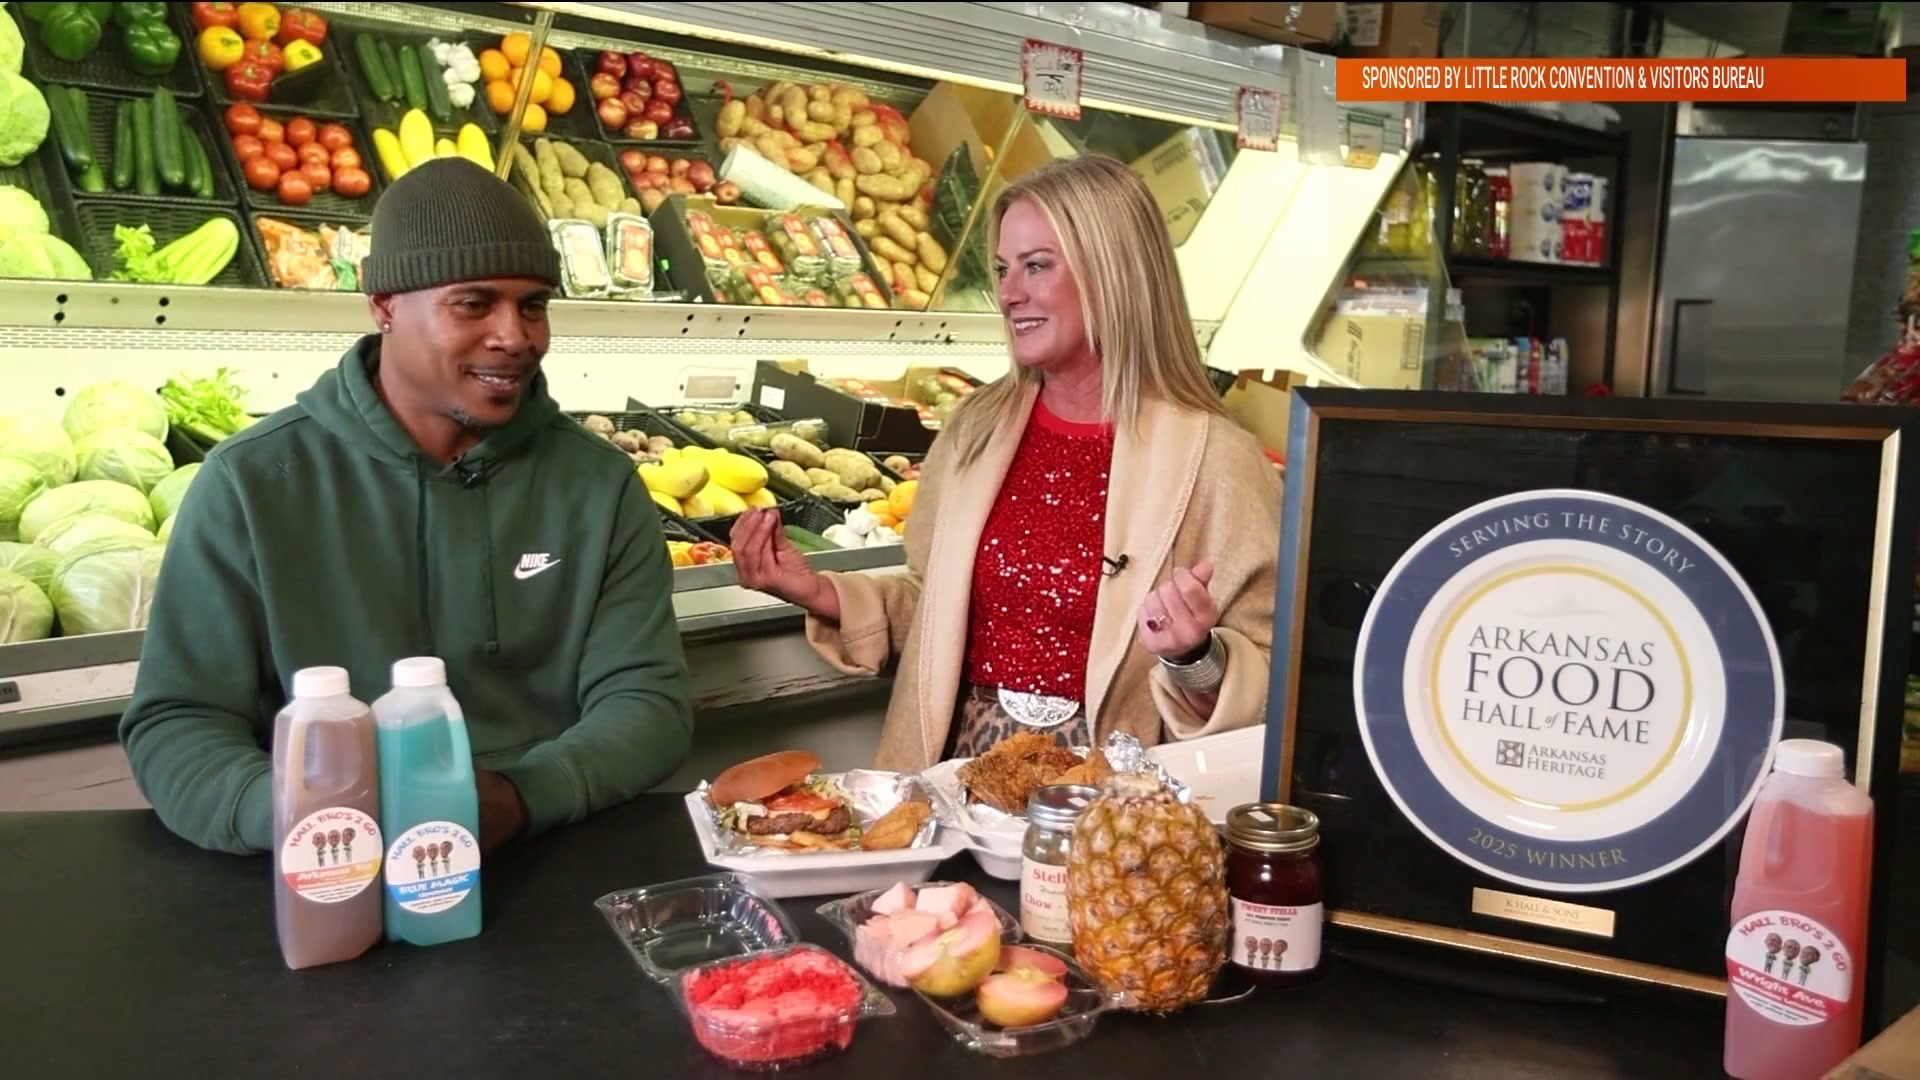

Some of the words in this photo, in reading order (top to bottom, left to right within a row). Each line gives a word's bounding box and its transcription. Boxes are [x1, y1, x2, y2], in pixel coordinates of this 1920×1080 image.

[520, 553, 551, 569] NIKE
[1448, 512, 1550, 557] SERVING
[1561, 512, 1611, 534] THE
[1618, 524, 1696, 576] STORY
[1468, 625, 1655, 667] ARKANSAS
[1464, 651, 1655, 713] FOOD
[1461, 698, 1541, 731] HALL
[1544, 712, 1561, 729] of
[1562, 711, 1650, 745] FAME
[1526, 758, 1606, 780] HERITAGE
[1527, 744, 1608, 766] ARKANSAS
[289, 822, 317, 847] HALL
[317, 811, 353, 823] BRO'S
[354, 816, 364, 825] 2
[391, 836, 416, 861] HALL
[416, 825, 450, 837] BRO'S
[451, 829, 460, 837] 2
[1467, 828, 1517, 859] 2025
[1526, 847, 1628, 869] WINNER
[430, 873, 470, 889] MAGIC
[1024, 892, 1053, 910] Chow
[1506, 898, 1514, 909] K
[1515, 900, 1539, 912] HALL
[1541, 904, 1550, 913] &
[1552, 906, 1580, 920] SONS
[1738, 916, 1775, 936] HALL
[1779, 916, 1824, 940] BRO'S
[1822, 939, 1835, 950] 2
[1831, 951, 1848, 972] GO
[1738, 967, 1789, 995] Wright
